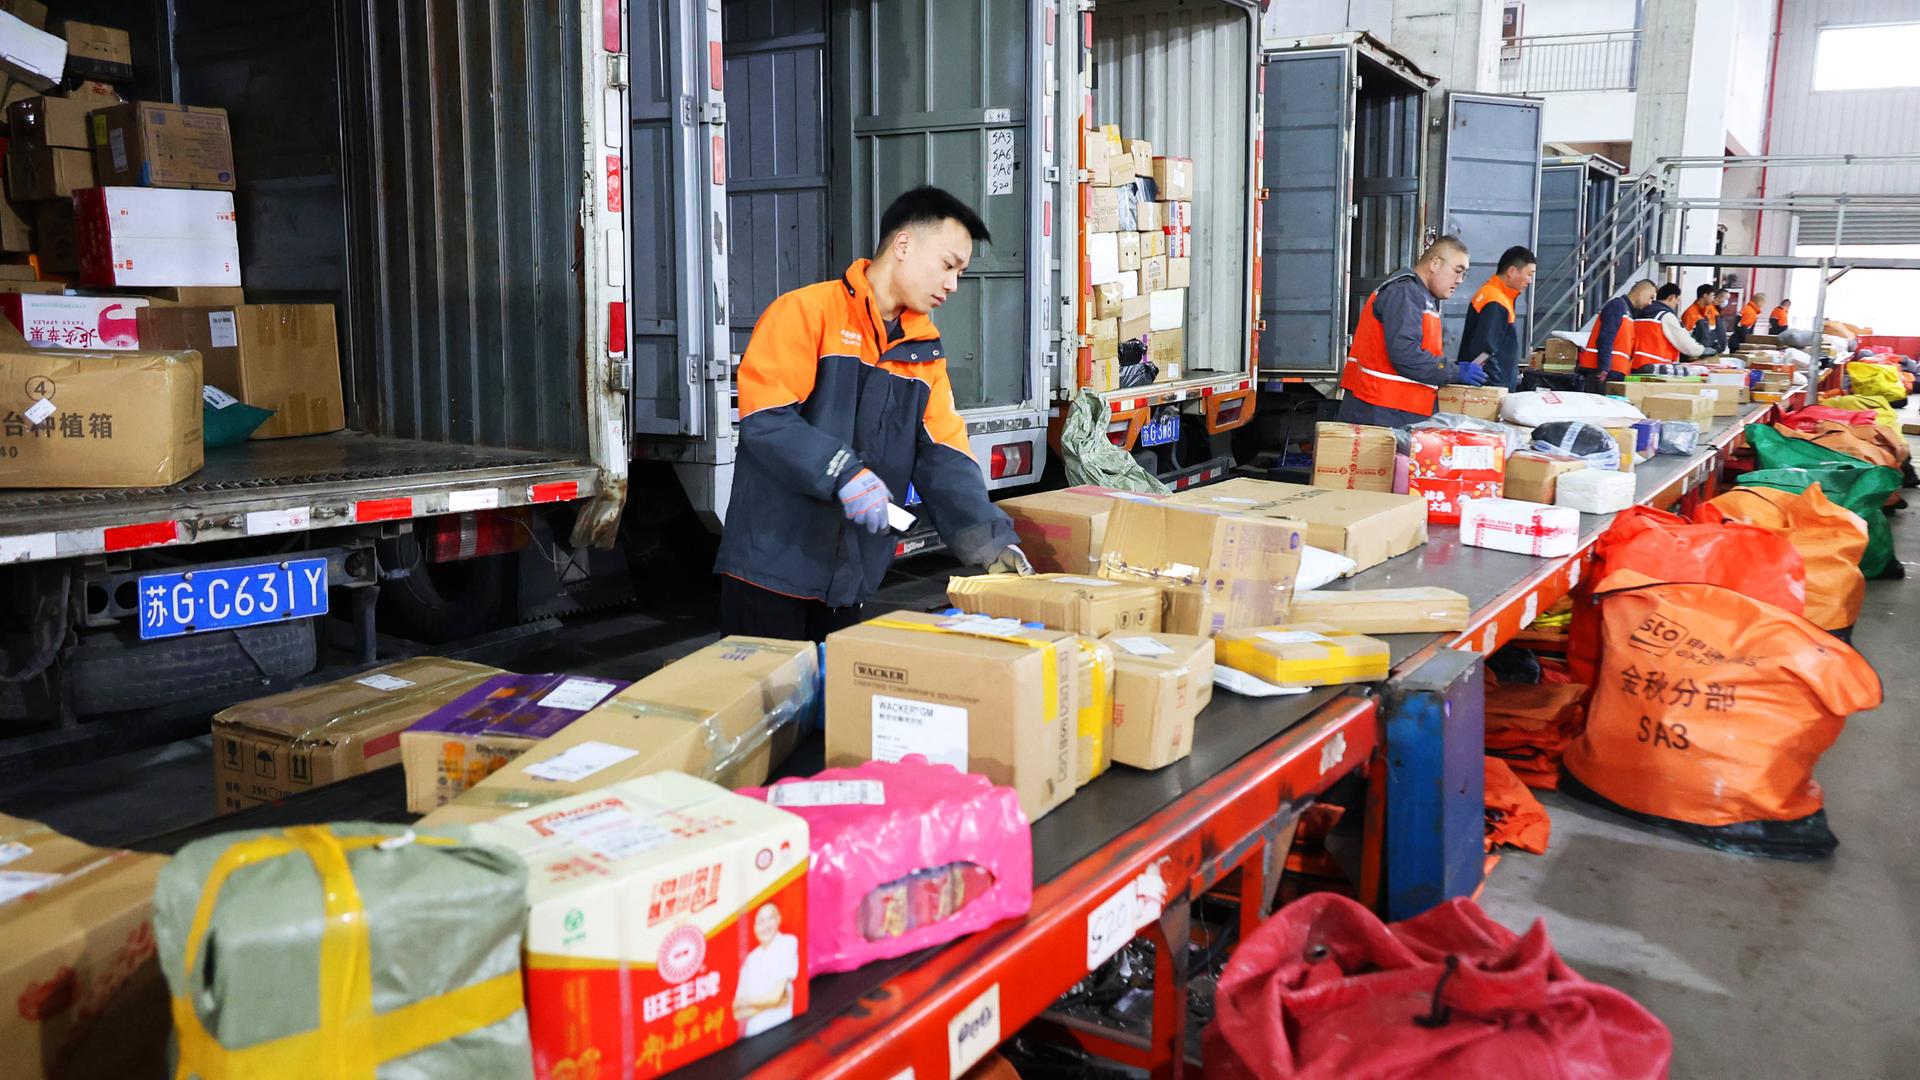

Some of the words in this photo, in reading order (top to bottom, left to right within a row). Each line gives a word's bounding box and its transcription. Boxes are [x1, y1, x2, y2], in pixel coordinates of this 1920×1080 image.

[993, 132, 1012, 144] SA3
[993, 147, 1013, 162] SA6
[993, 181, 1009, 194] S20
[30, 326, 98, 349] 延安苹果
[146, 566, 323, 628] 苏G·C631Y
[857, 666, 904, 681] WACKER
[1621, 664, 1736, 712] 金秋分部
[1637, 715, 1690, 750] SA3
